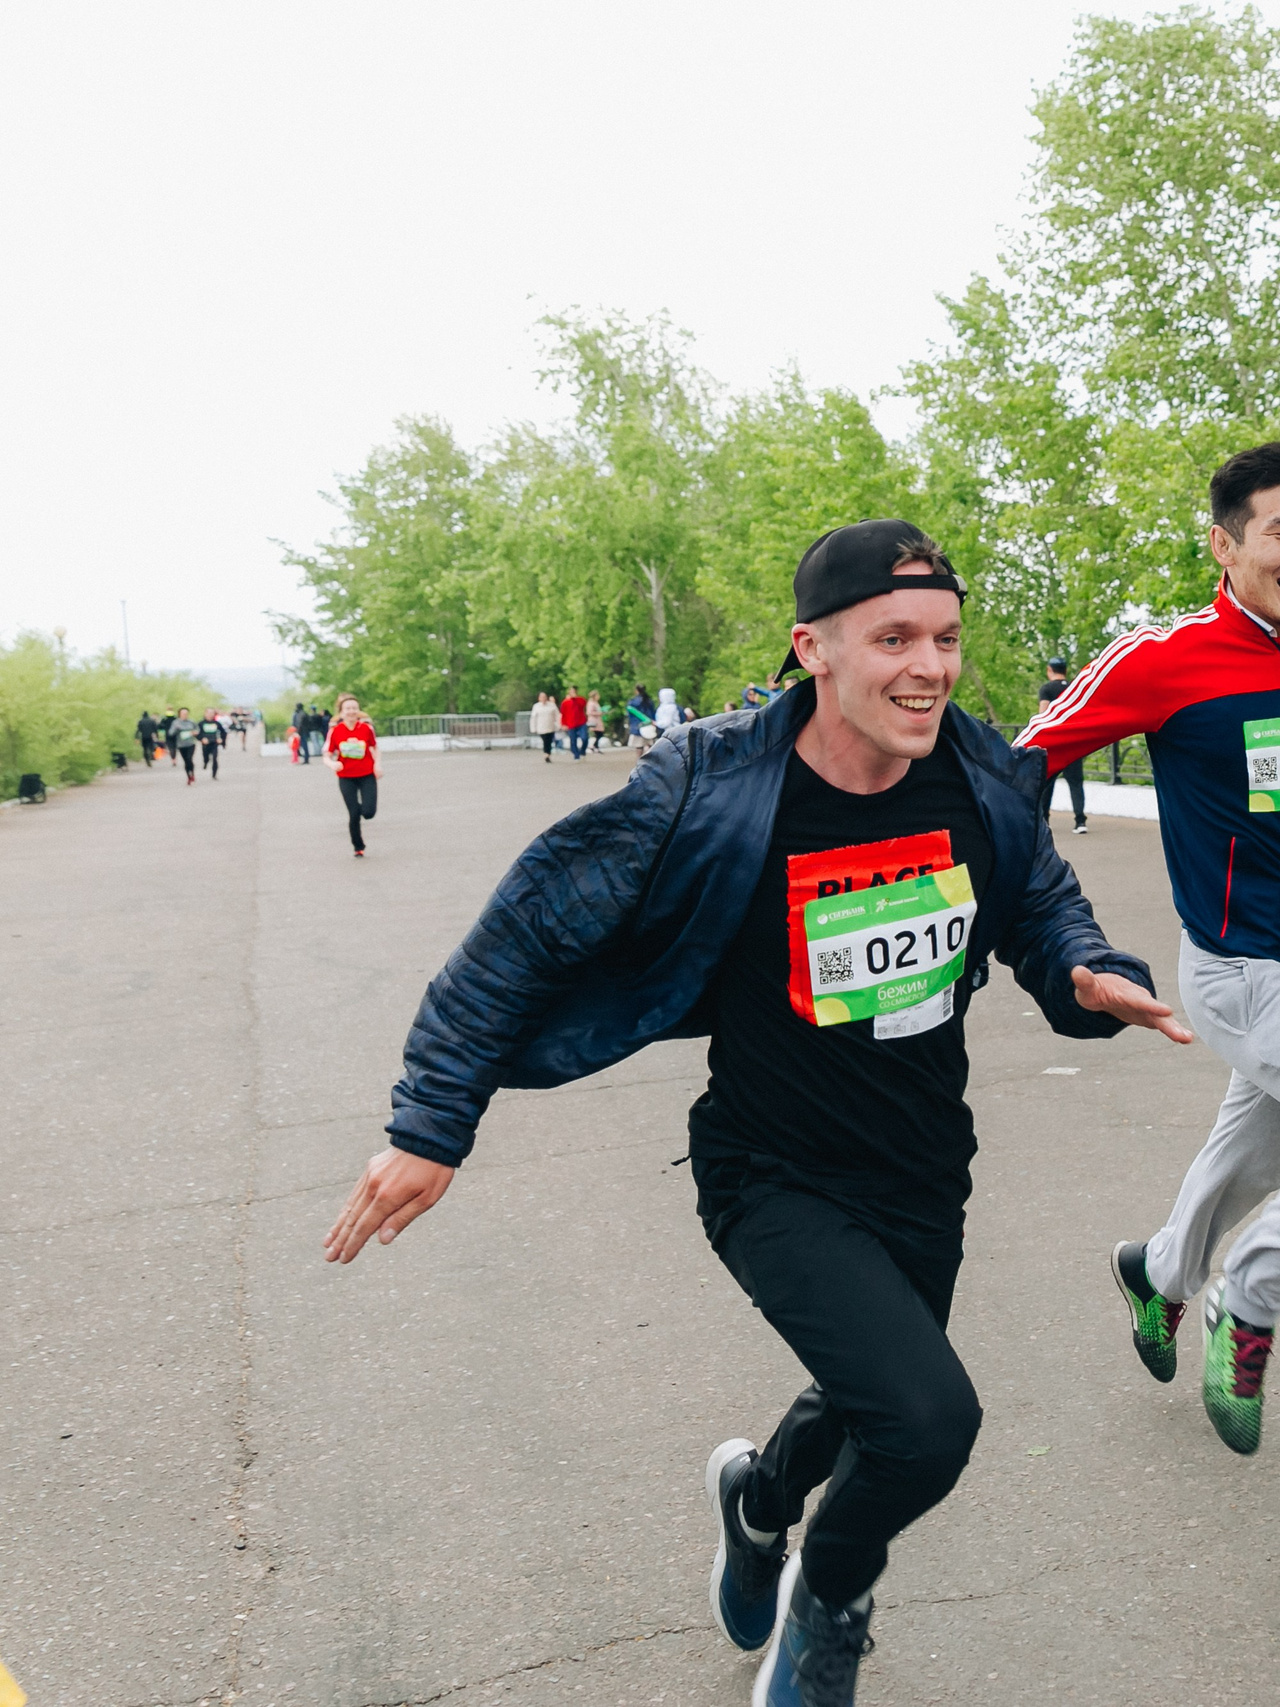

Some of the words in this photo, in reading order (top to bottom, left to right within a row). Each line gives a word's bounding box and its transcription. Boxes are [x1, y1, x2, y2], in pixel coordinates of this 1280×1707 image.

[829, 906, 866, 920] СБЕРБАНК
[865, 915, 966, 975] 0210
[877, 978, 928, 1001] бежим
